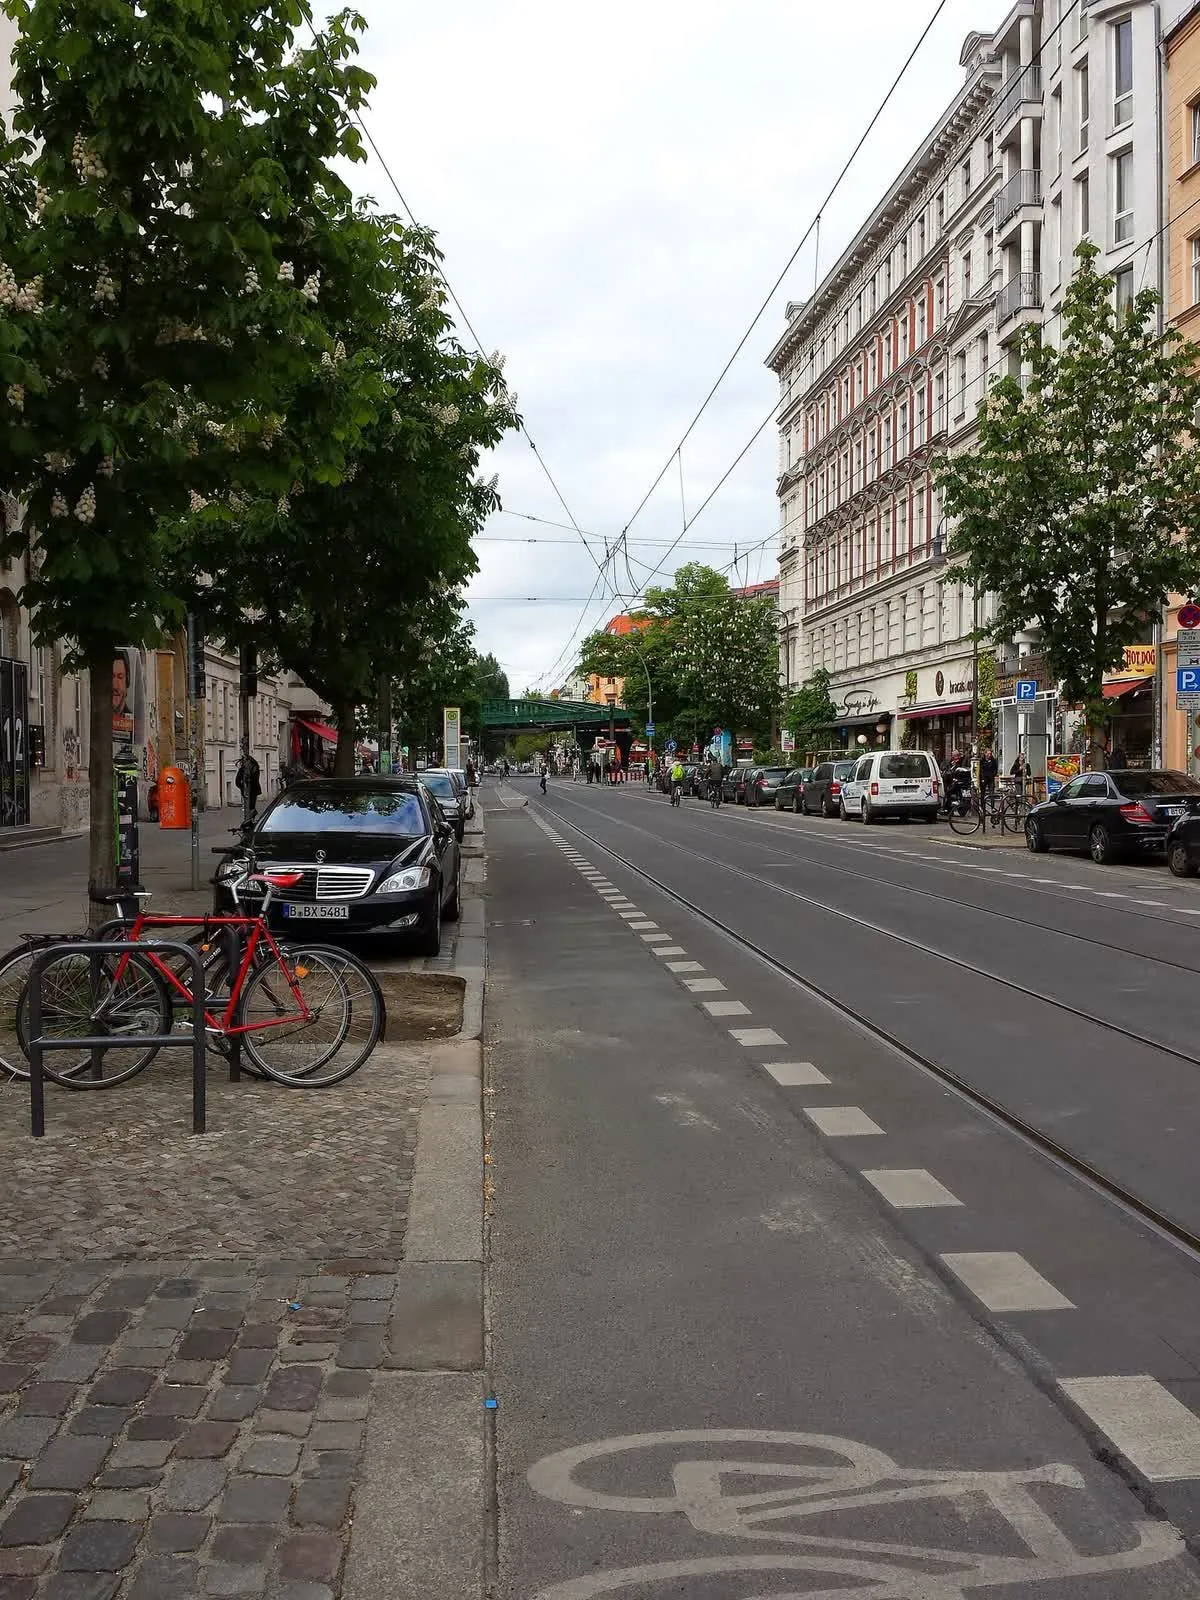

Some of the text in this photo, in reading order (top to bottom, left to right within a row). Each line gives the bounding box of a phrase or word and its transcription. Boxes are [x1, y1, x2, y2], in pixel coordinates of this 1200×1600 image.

[1126, 648, 1155, 668] HOT DOG
[1182, 671, 1196, 690] P
[1021, 684, 1031, 698] P
[3, 717, 23, 762] 12
[303, 906, 318, 917] BX
[320, 906, 347, 917] 5481
